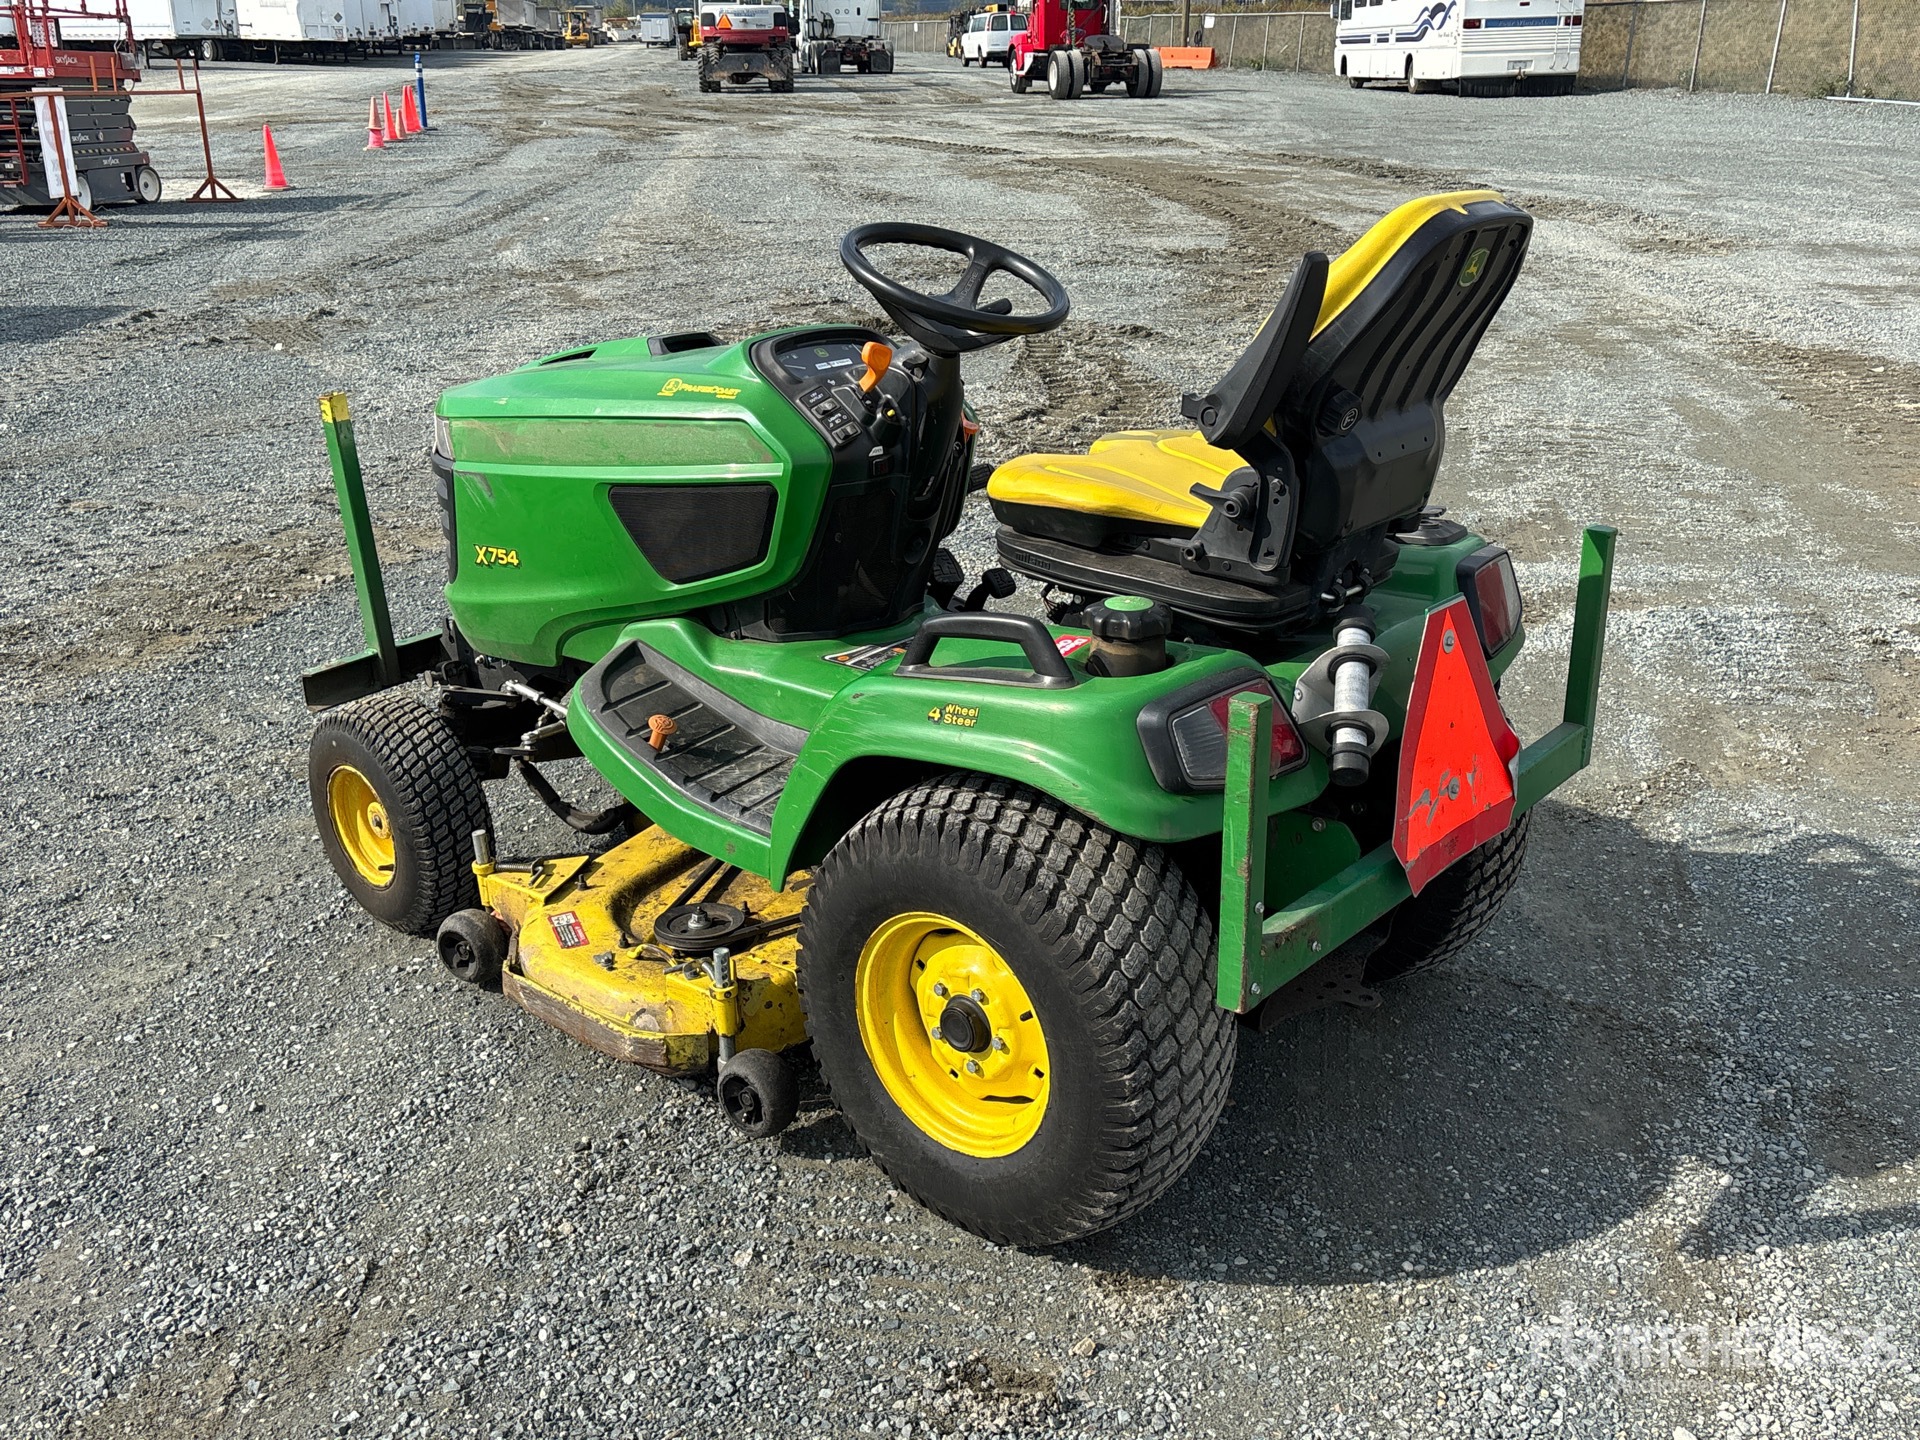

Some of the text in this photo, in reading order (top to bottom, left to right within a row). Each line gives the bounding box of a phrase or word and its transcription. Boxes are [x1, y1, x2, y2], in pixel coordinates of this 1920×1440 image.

[55, 54, 78, 65] SKYJACK
[474, 545, 519, 566] X754
[928, 704, 979, 722] 4 Wheel
[943, 713, 977, 727] Steer
